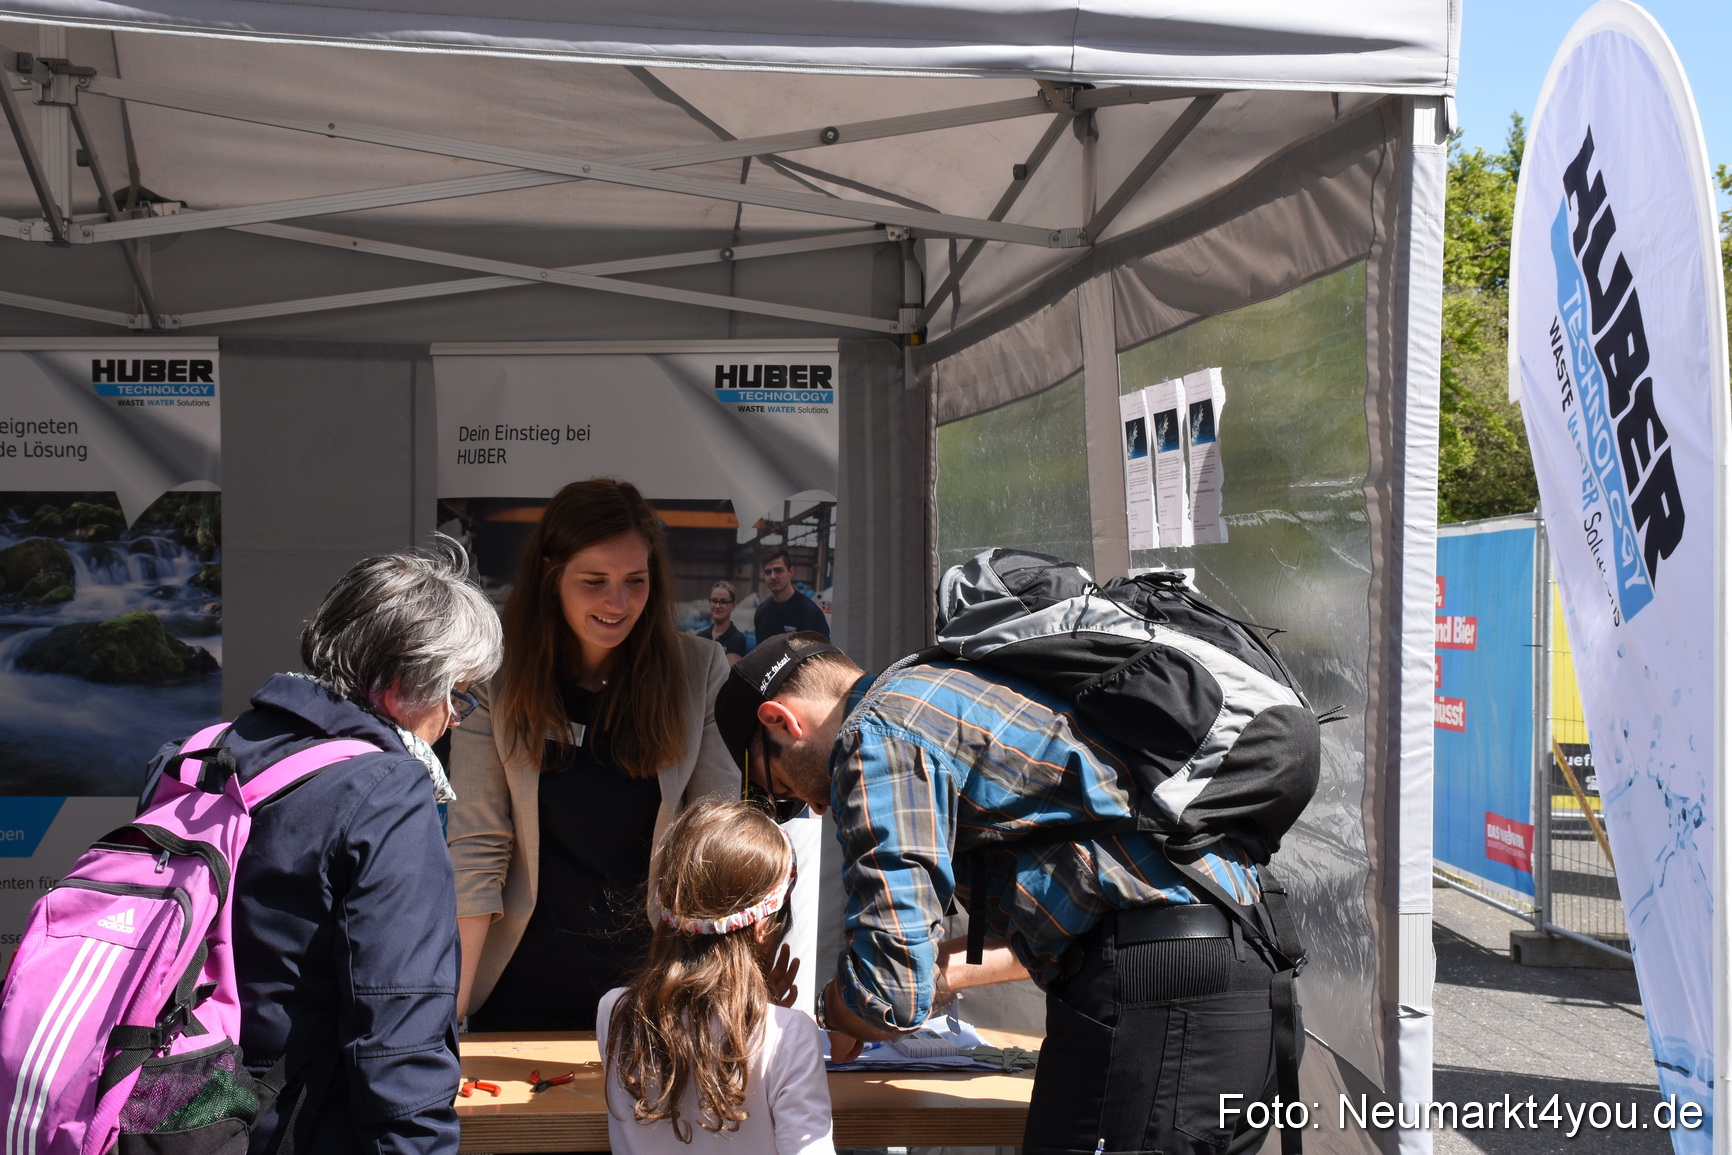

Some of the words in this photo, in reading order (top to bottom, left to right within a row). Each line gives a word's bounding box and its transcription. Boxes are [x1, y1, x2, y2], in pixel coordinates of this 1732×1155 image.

[1549, 315, 1574, 413] WASTE
[1563, 123, 1685, 591] HUBER
[92, 359, 214, 383] HUBER
[715, 365, 833, 389] HUBER
[117, 385, 209, 395] TECHNOLOGY
[738, 391, 828, 402] TECHNOLOGY
[117, 399, 145, 407] WASTE
[147, 399, 175, 407] WATER
[177, 399, 210, 407] Solutions
[738, 405, 765, 413] WASTE
[797, 406, 829, 414] Solutions
[459, 425, 490, 442] Dein
[495, 424, 560, 445] Einstieg
[566, 424, 591, 441] bei
[1563, 279, 1647, 590] TECHNOLOGY
[24, 441, 88, 461] Lösung
[457, 448, 507, 464] HUBER
[1454, 617, 1475, 645] Bier
[97, 918, 135, 934] adidas
